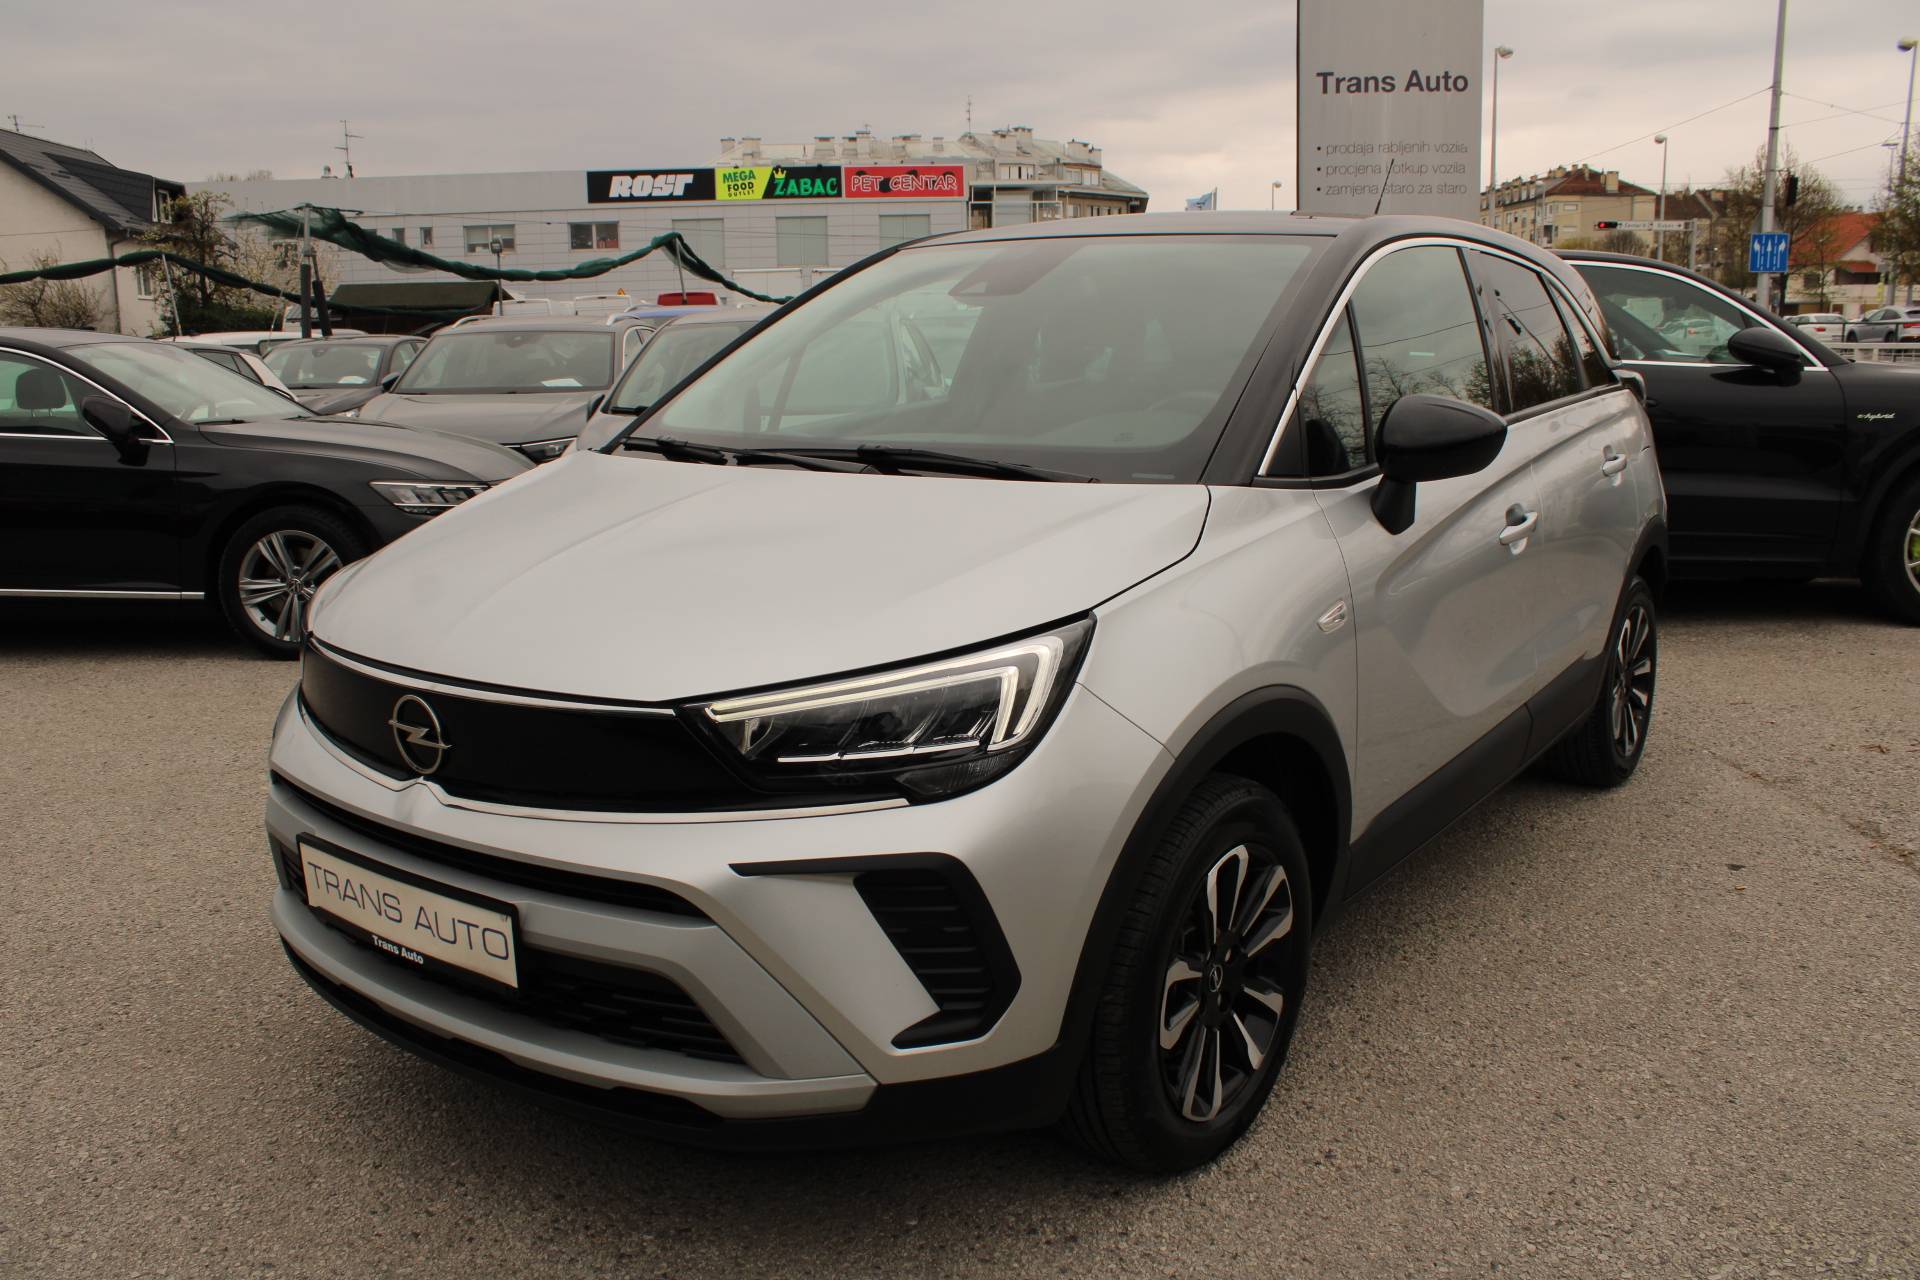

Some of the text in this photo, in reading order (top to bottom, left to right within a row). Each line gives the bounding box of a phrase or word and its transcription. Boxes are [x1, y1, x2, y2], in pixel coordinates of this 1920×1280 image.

[1316, 69, 1469, 94] Trans Auto
[1326, 140, 1468, 157] prodaja rabljenih vozila
[722, 170, 756, 184] MEGA
[1326, 162, 1381, 178] procjena
[1392, 162, 1429, 177] otkup
[1432, 161, 1466, 174] vozila
[608, 174, 694, 198] ROST
[727, 182, 754, 192] FOOD
[851, 174, 958, 192] PET CENTAR
[1326, 182, 1468, 197] zamjena staro za staro
[728, 190, 754, 198] OUTLET
[308, 862, 509, 960] TRANS AUTO
[372, 934, 424, 965] Trans Auto
